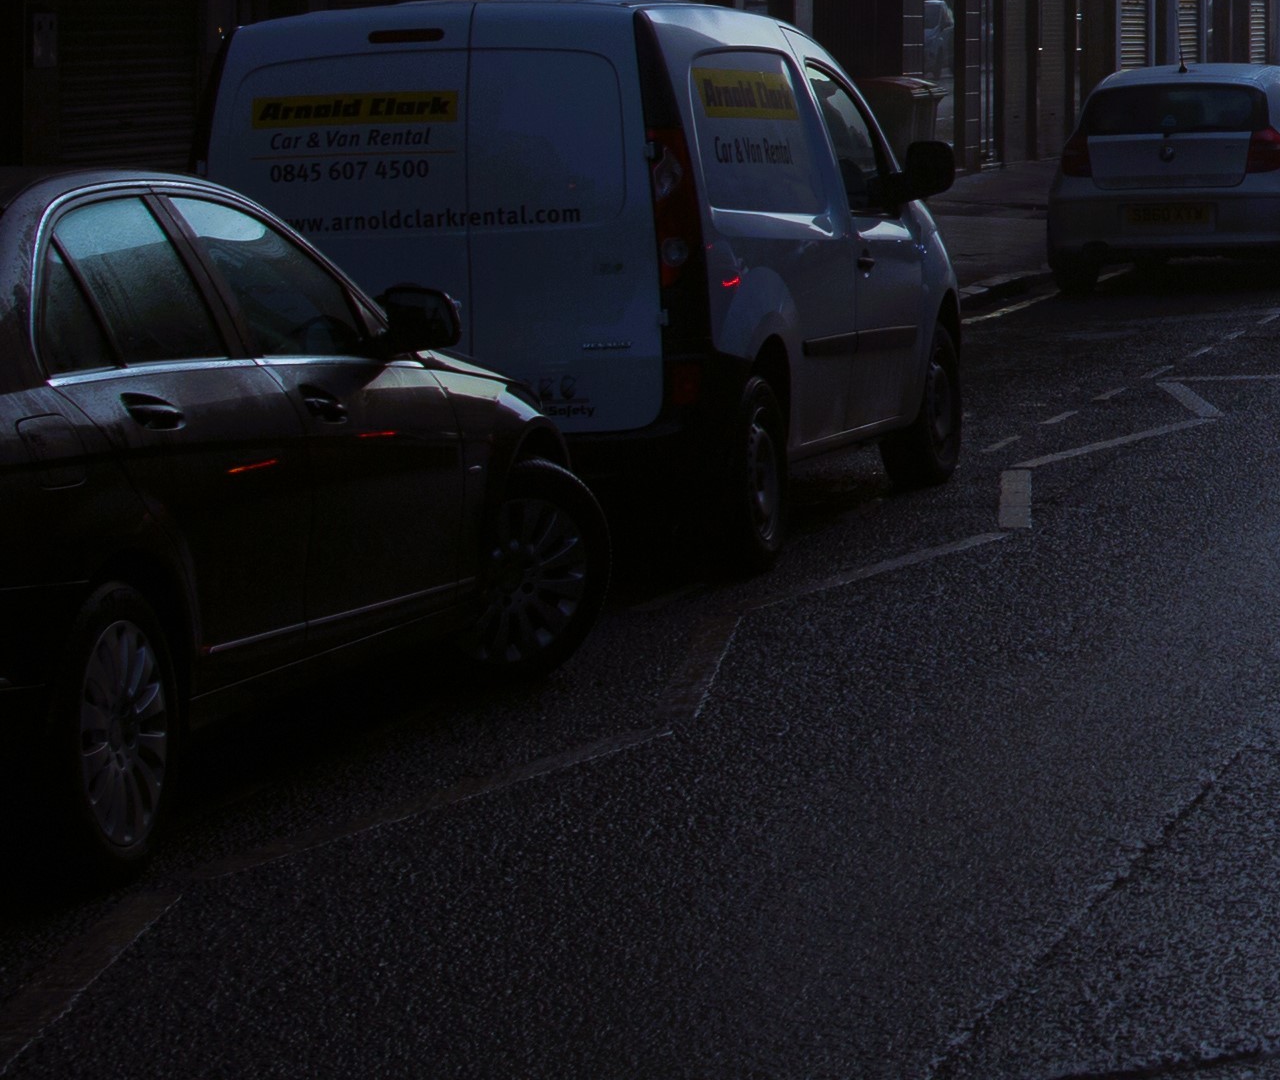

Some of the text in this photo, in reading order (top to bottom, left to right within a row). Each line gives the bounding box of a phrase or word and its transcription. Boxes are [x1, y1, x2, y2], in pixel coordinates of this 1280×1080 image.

[259, 96, 450, 121] Arnold Clark
[270, 127, 431, 151] Car & Van Rental
[714, 136, 732, 164] Car
[743, 138, 763, 164] Van
[764, 139, 794, 165] Rental
[270, 159, 430, 183] 0845 607 4500
